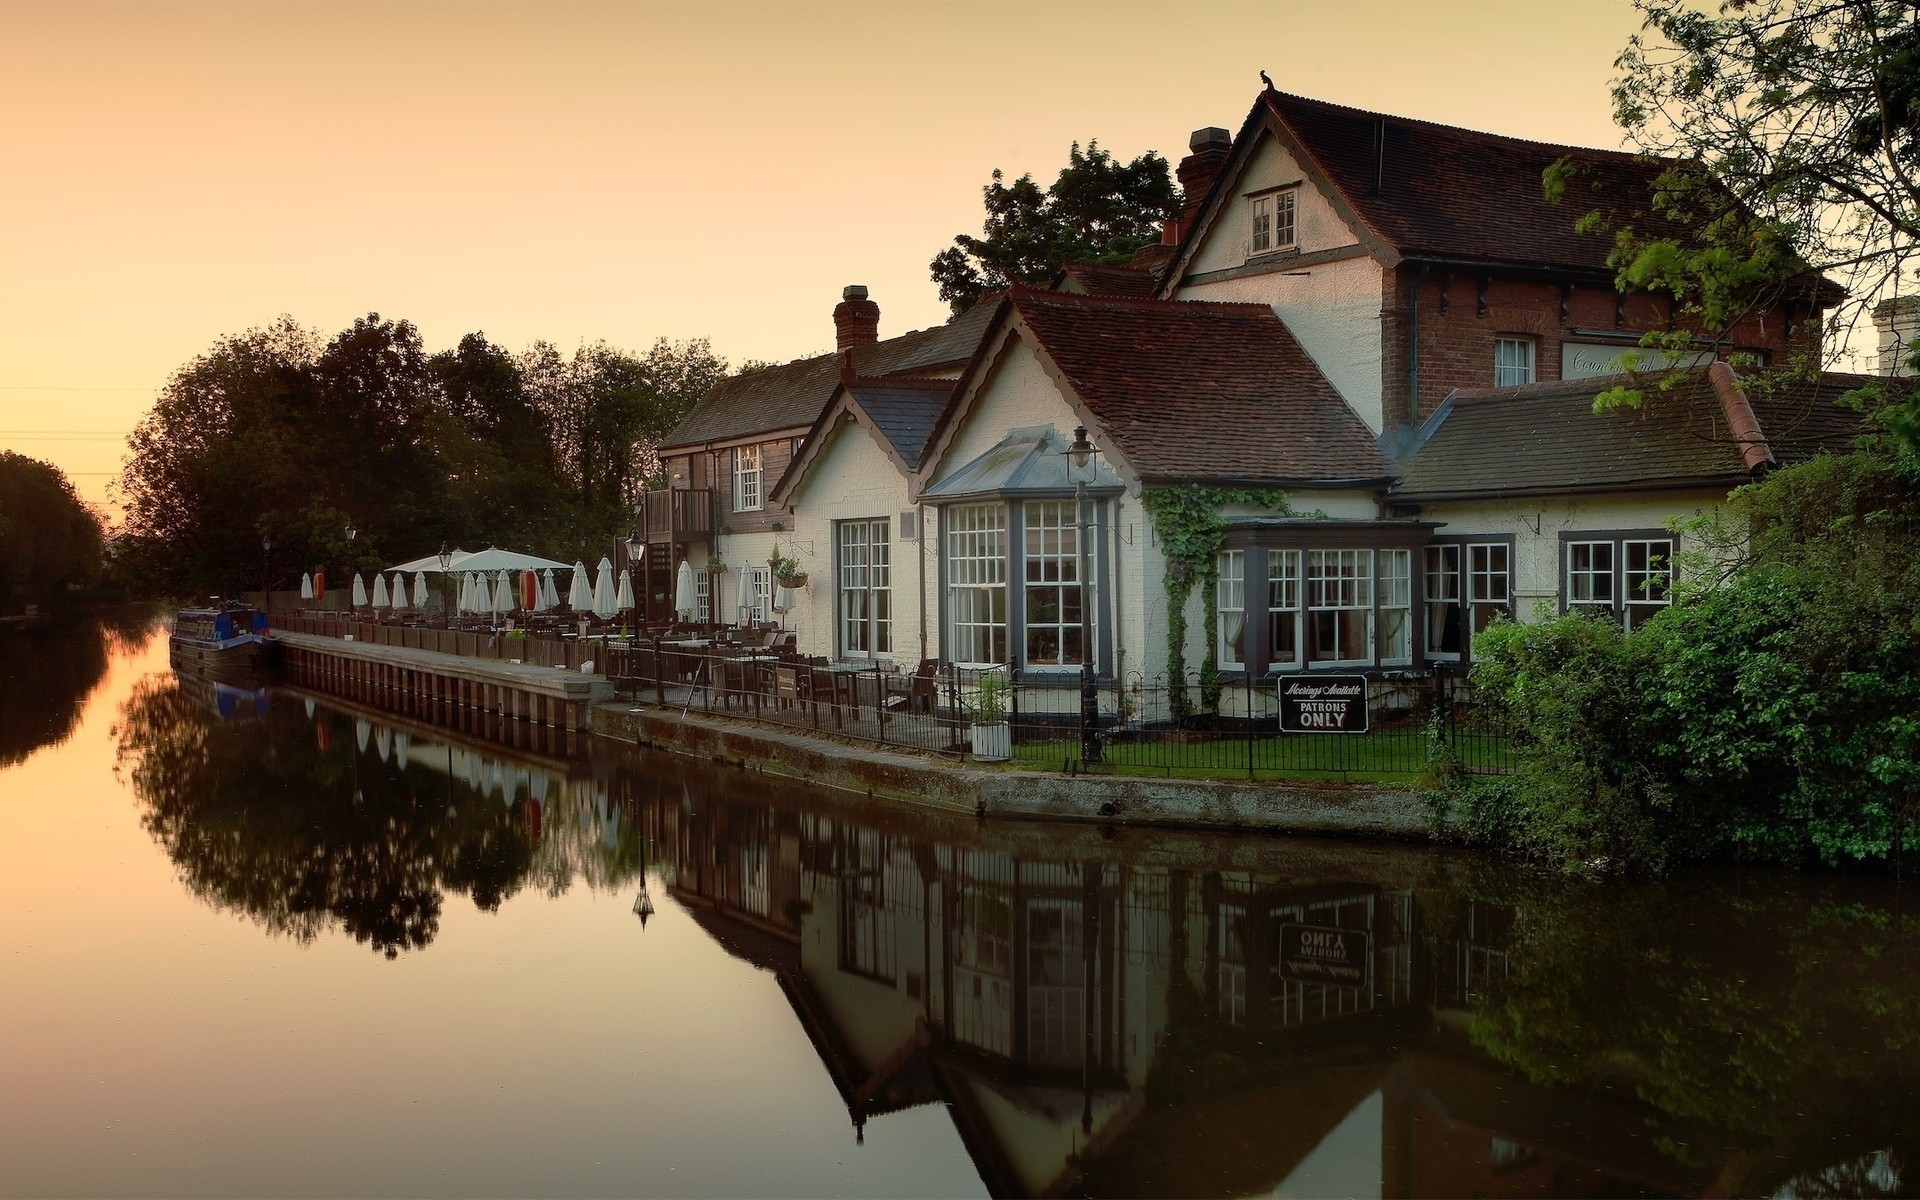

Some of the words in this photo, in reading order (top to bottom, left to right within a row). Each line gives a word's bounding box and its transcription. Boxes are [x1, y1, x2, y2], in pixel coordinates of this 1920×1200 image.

[1284, 682, 1322, 699] Moorings
[1322, 683, 1361, 695] Available
[1300, 702, 1346, 712] PATRONS
[1300, 712, 1345, 727] ONLY
